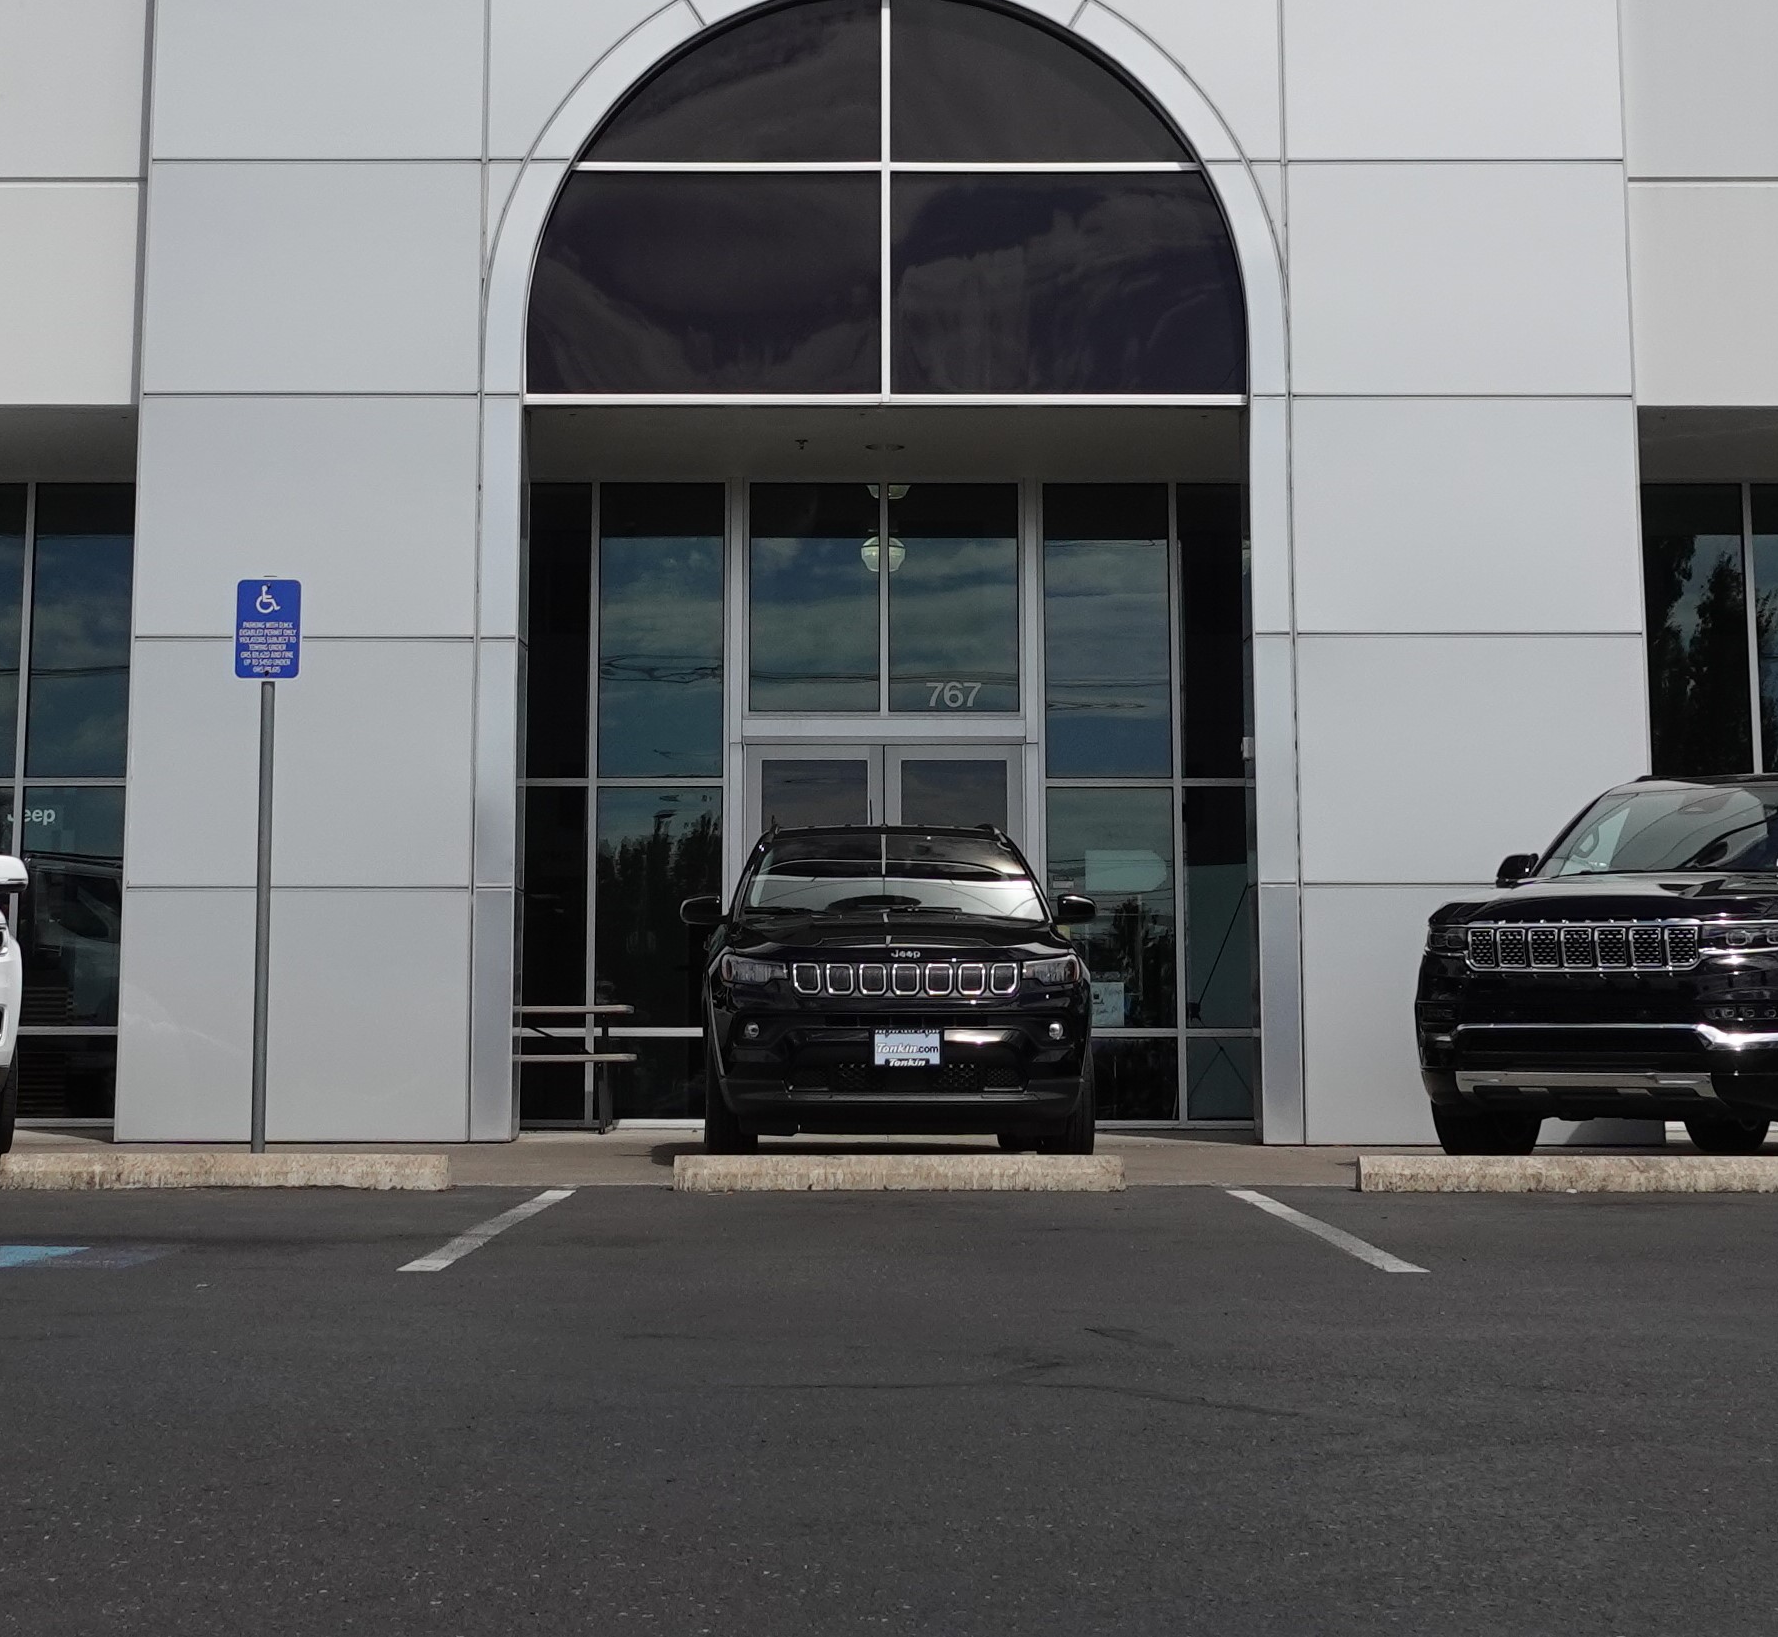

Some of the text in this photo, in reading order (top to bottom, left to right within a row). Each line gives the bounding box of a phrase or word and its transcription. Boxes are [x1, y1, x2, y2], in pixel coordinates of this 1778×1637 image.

[925, 681, 982, 708] 767
[890, 949, 921, 959] Jeep
[876, 1043, 939, 1054] Tonkin.com
[888, 1058, 926, 1067] Tonkin
